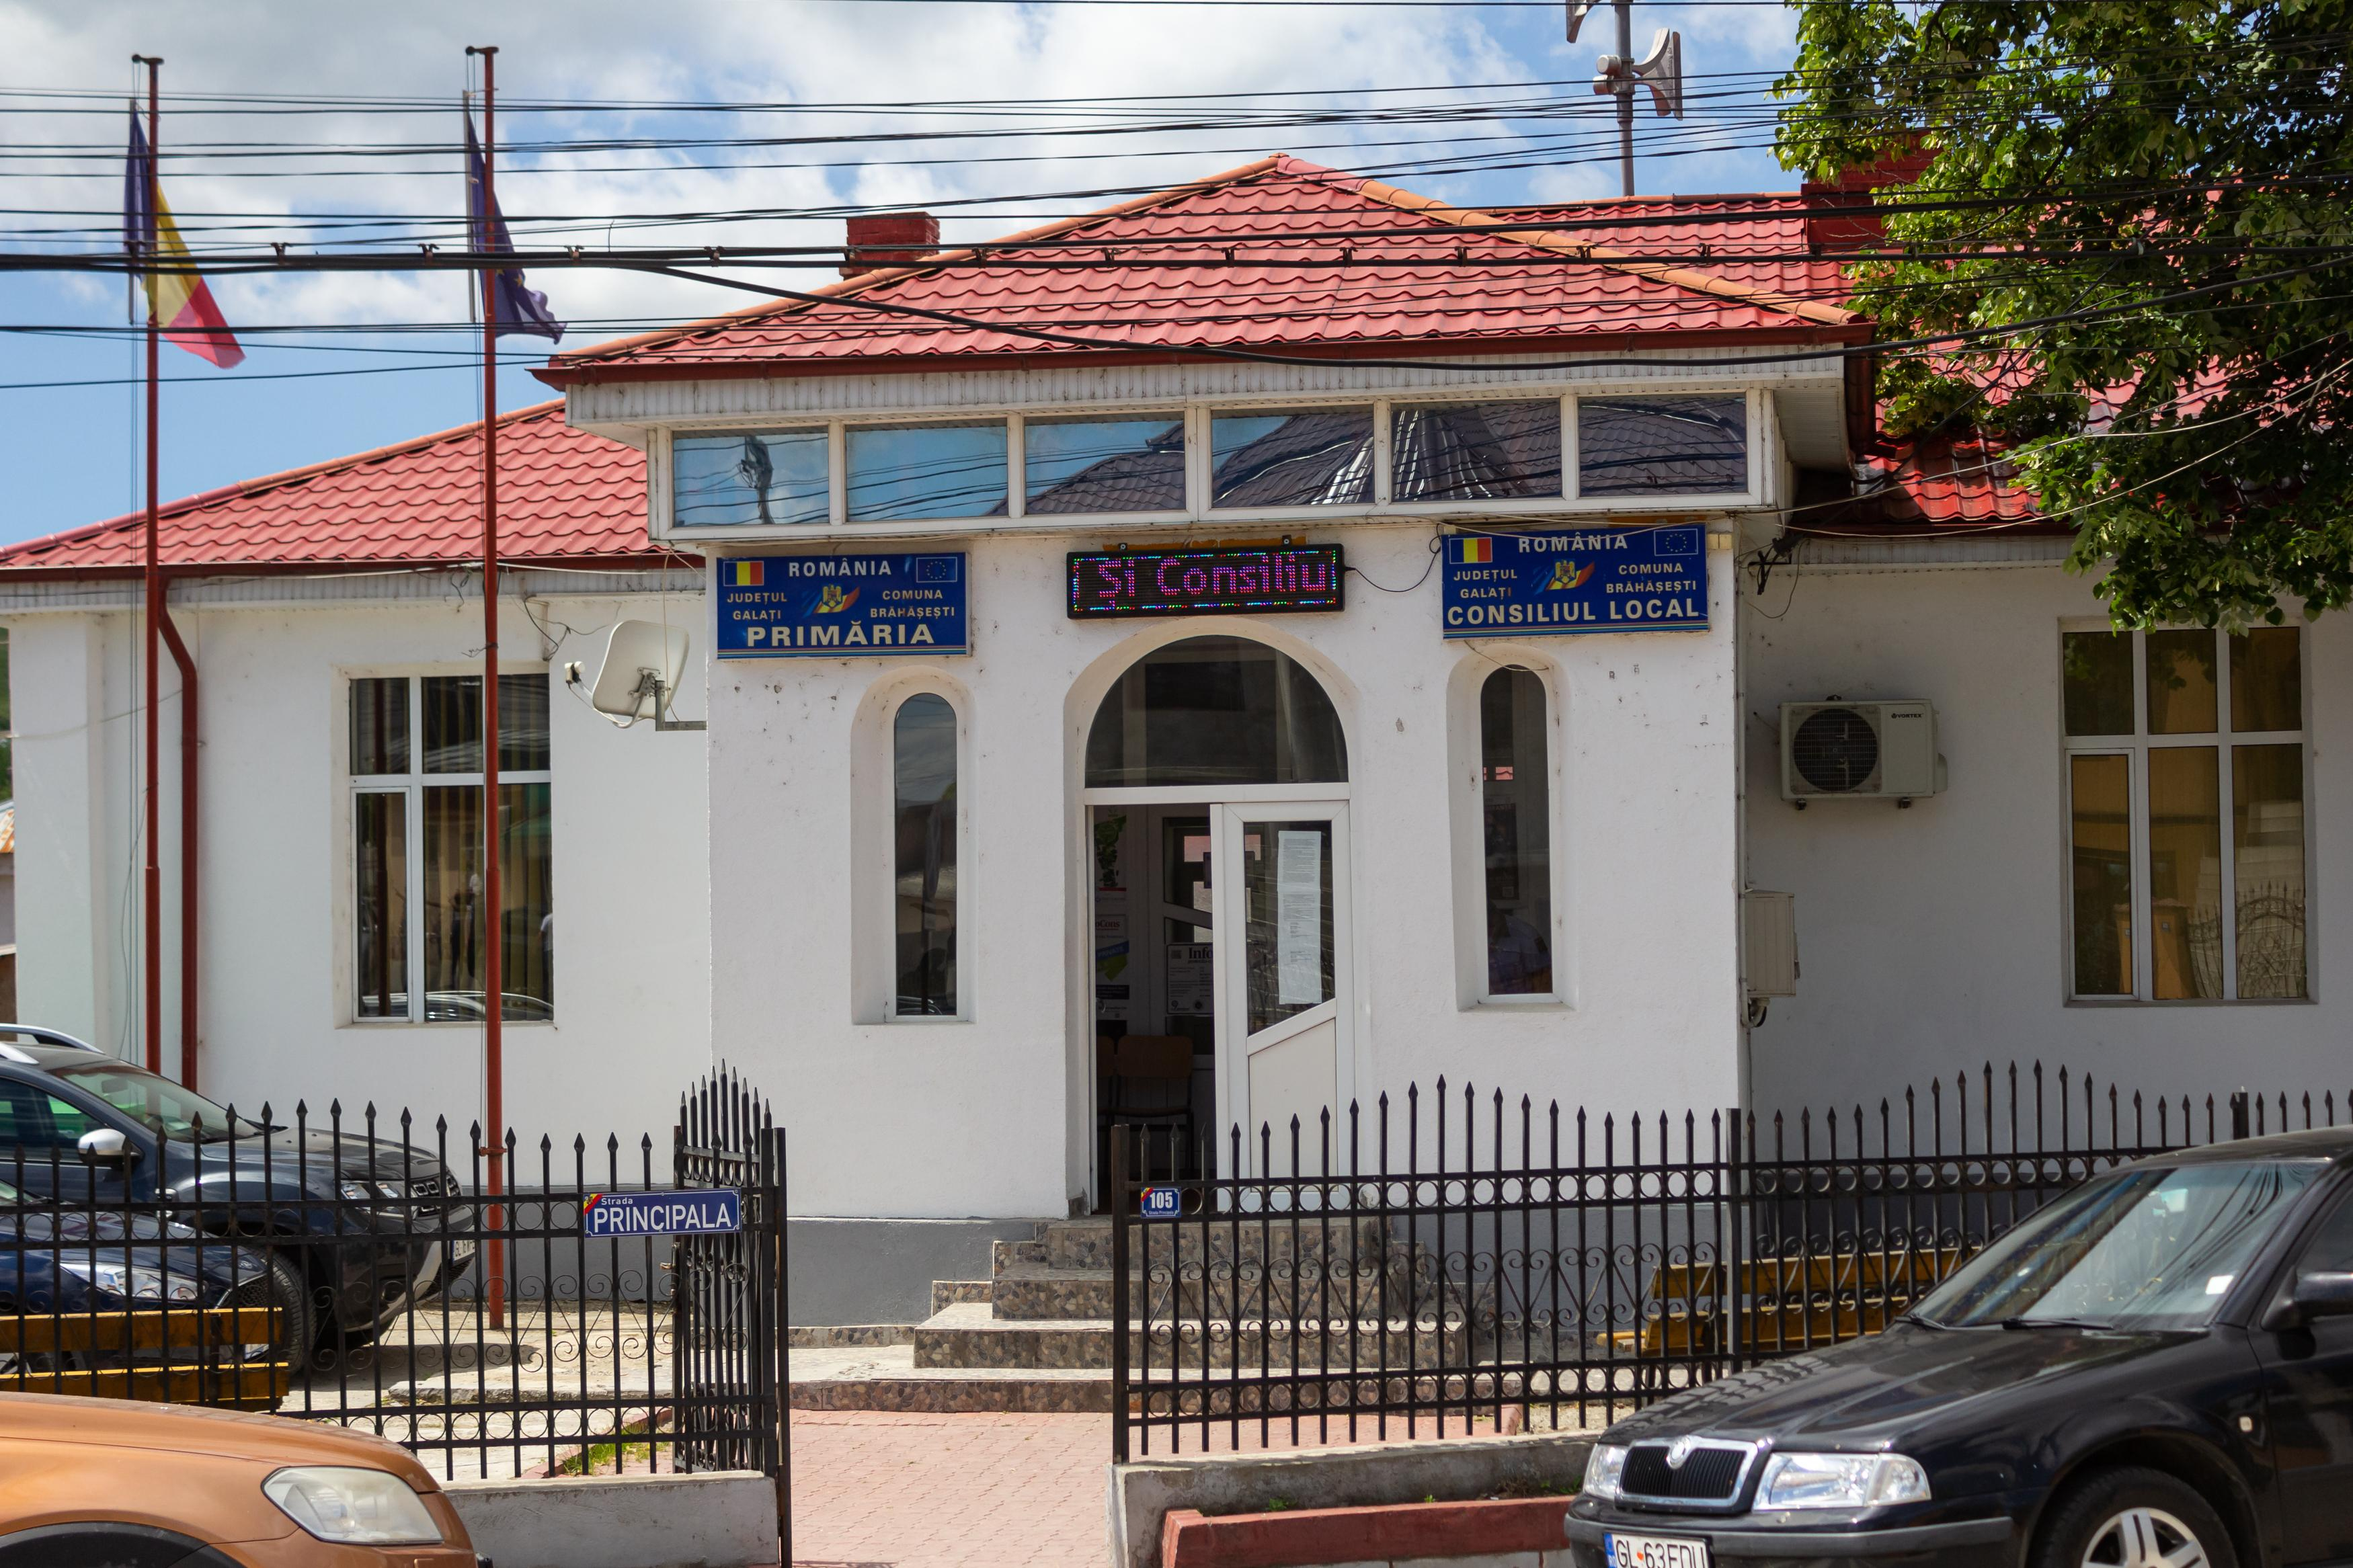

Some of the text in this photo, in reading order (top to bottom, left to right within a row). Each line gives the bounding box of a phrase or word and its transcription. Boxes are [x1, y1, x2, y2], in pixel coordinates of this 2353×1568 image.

[1519, 532, 1628, 552] ROMÂNIA
[789, 558, 891, 577] ROMÂNIA
[1619, 563, 1683, 575] COMUNA
[1158, 554, 1326, 596] Consiliu
[1453, 569, 1517, 582] JUDEȚUL
[1460, 587, 1511, 600] GALAȚI
[1606, 580, 1696, 594] BRĂHĂȘEȘTI
[727, 592, 787, 605] JUDEȚUL
[883, 589, 943, 600] COMUNA
[733, 610, 781, 622] GALAȚI
[871, 606, 955, 620] BRĂHĂȘEȘTI
[1447, 599, 1699, 625] CONSILIUL LOCAL
[747, 620, 934, 647] PRIMĂRIA
[601, 1197, 633, 1206] Strada
[1150, 1192, 1173, 1208] 105
[594, 1203, 732, 1233] PRINCIPALA
[1616, 1540, 1638, 1568] GL
